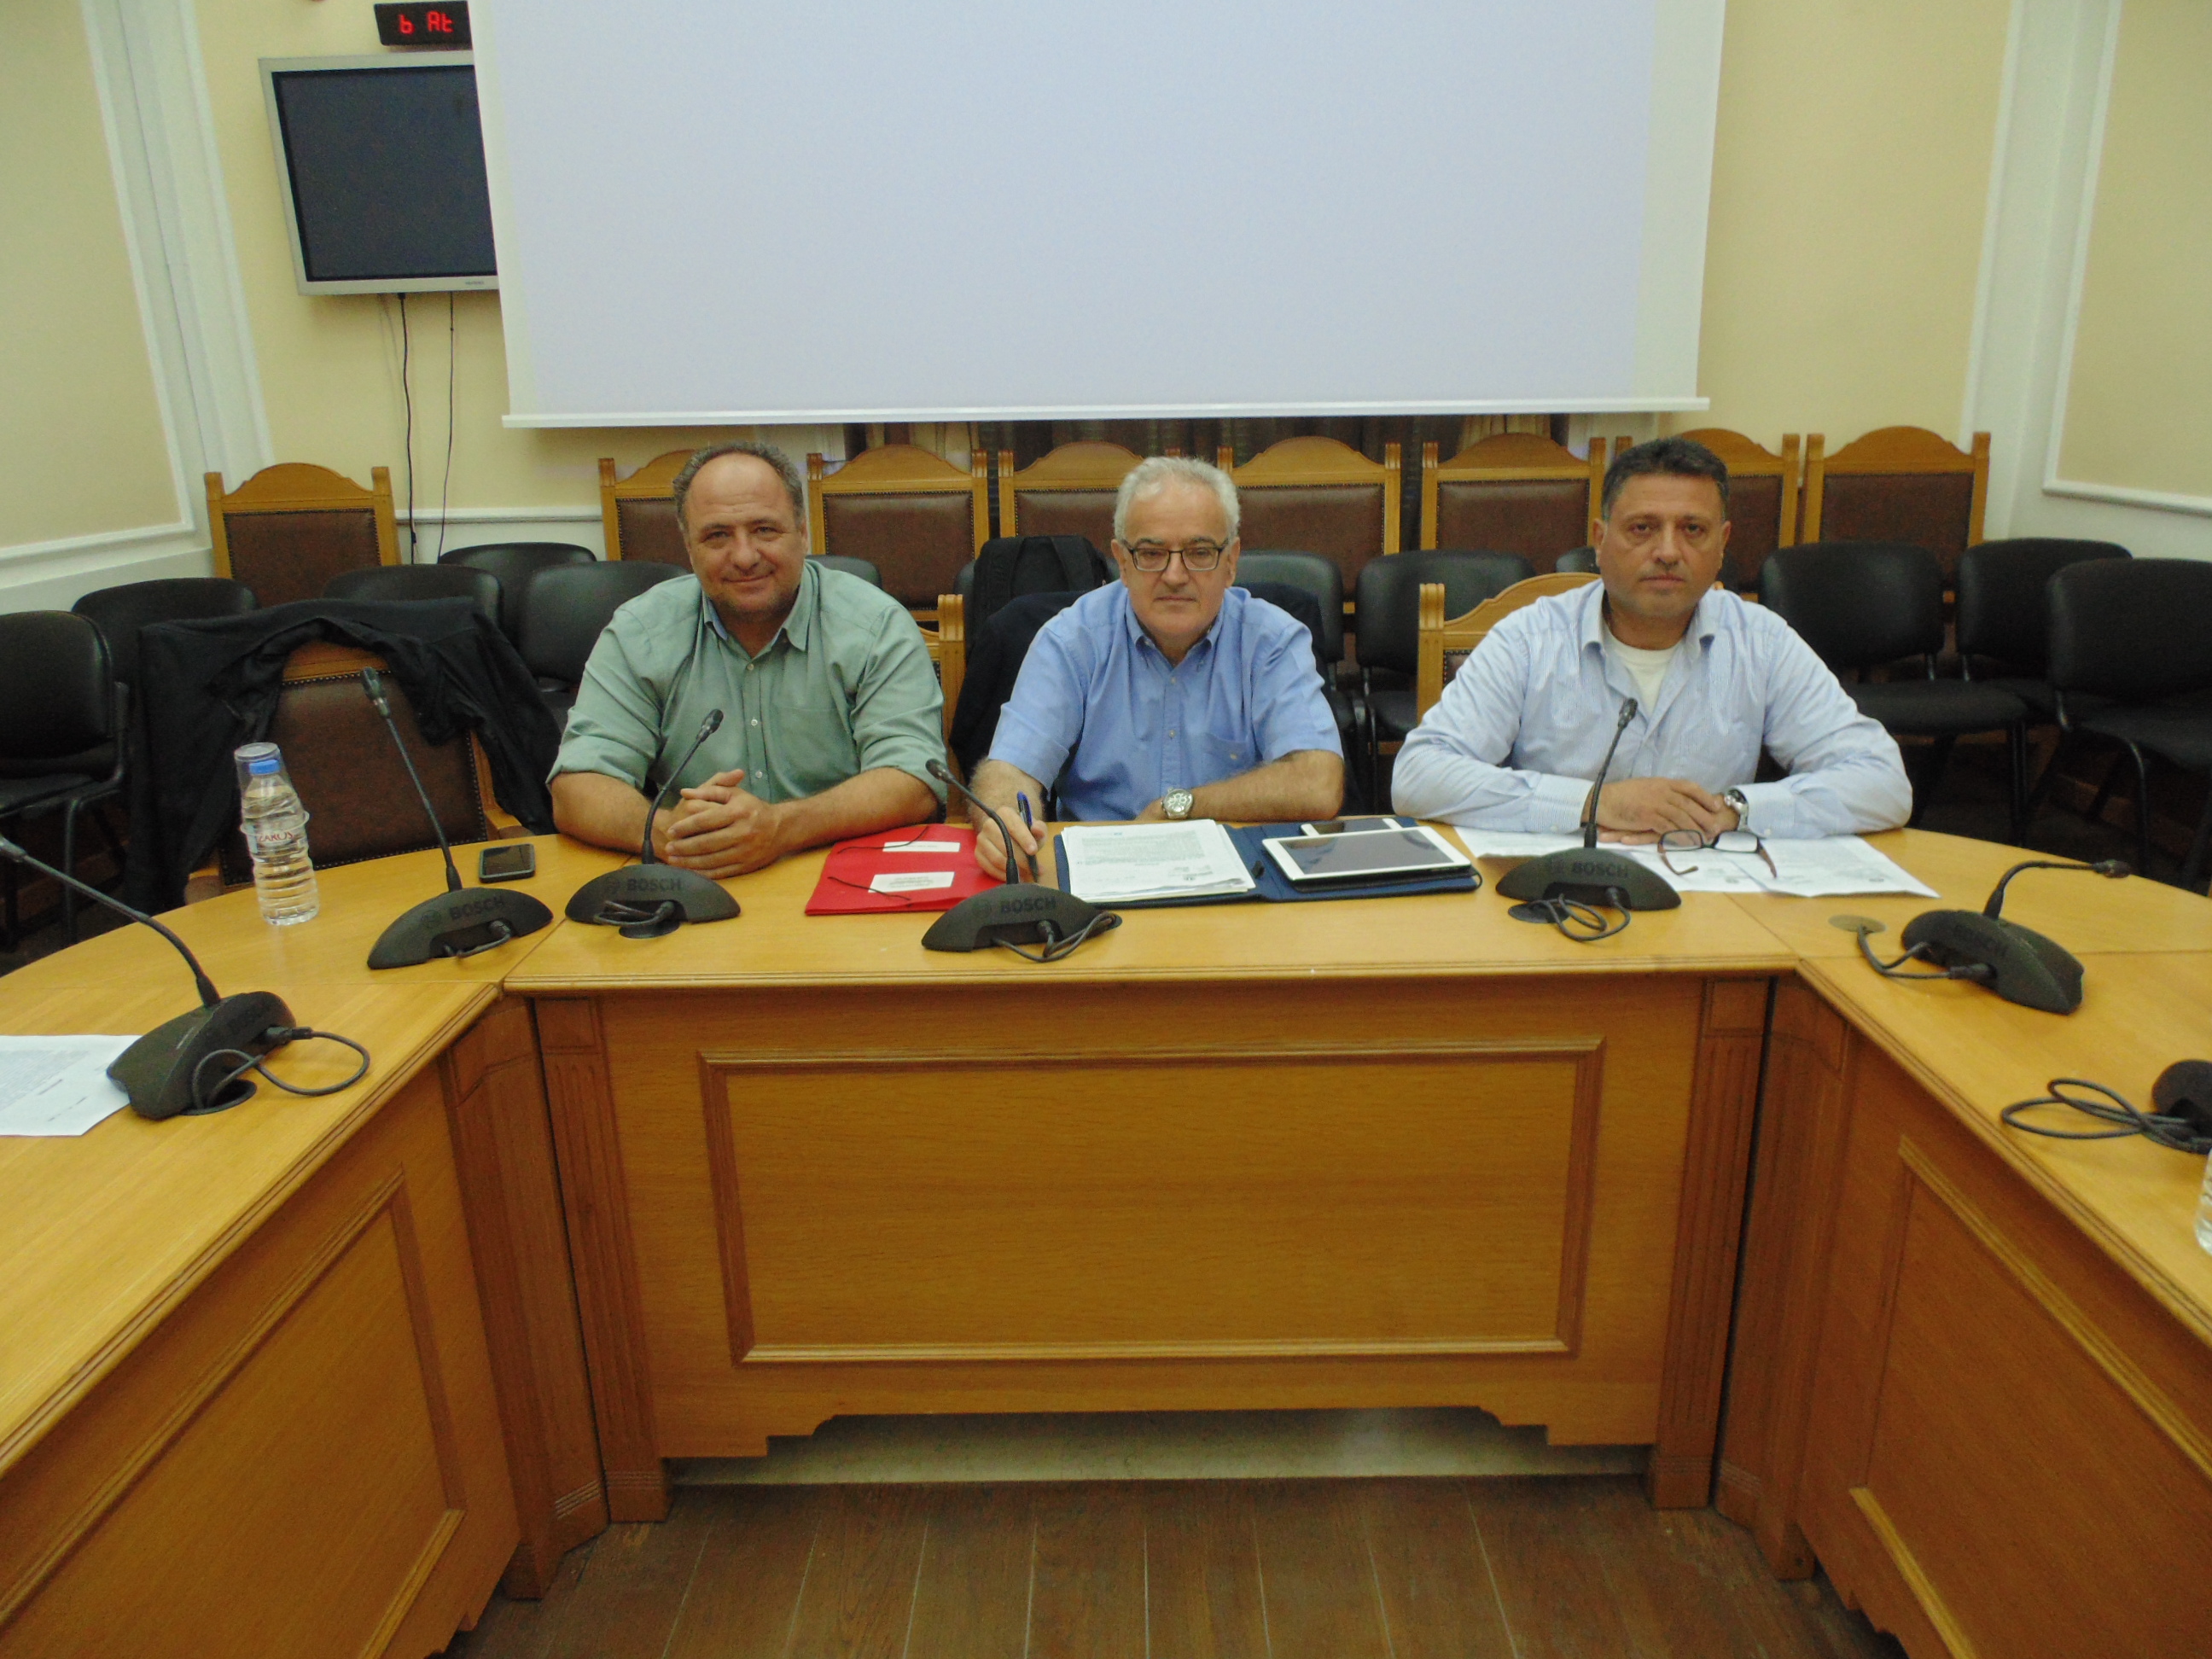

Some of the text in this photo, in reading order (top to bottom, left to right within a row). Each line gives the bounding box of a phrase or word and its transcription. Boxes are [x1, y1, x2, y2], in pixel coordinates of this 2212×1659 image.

[1572, 861, 1628, 878] BOSCH
[627, 877, 682, 891] BOSCH
[449, 895, 505, 920] BOSCH
[999, 896, 1057, 914] BOSCH
